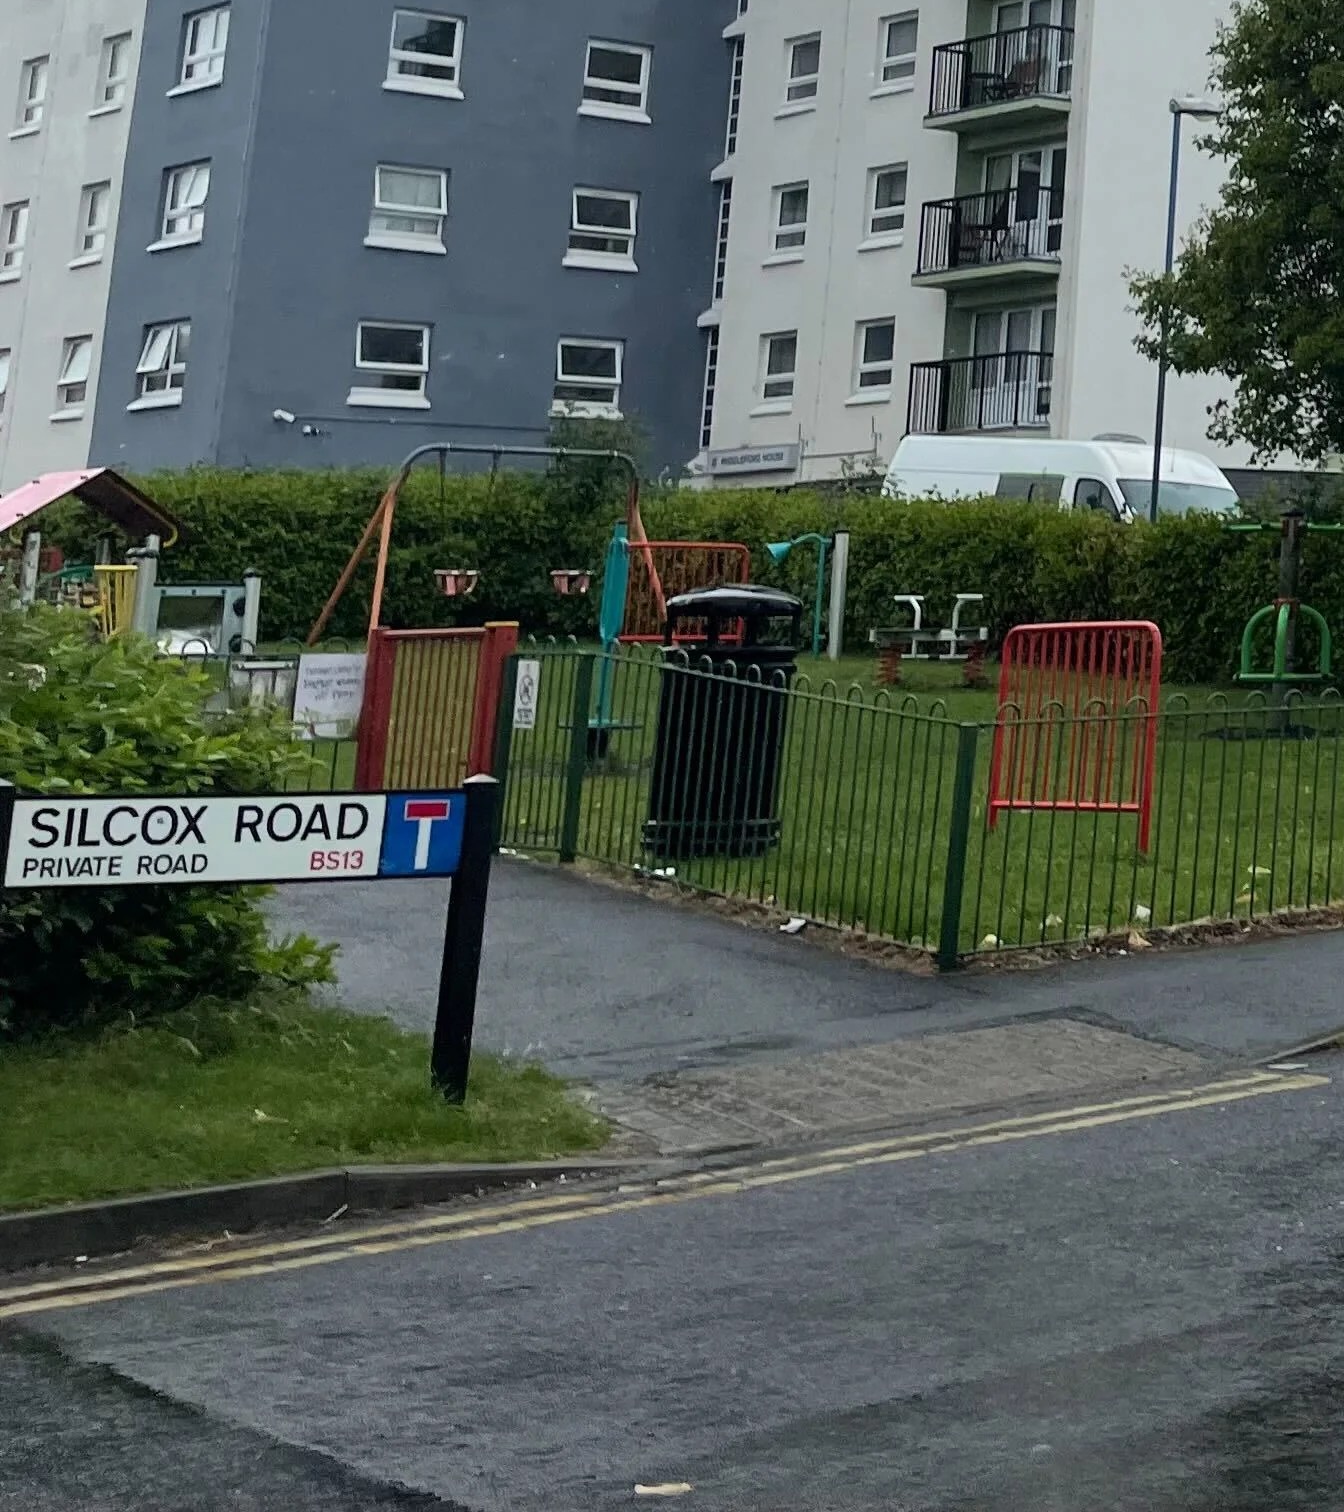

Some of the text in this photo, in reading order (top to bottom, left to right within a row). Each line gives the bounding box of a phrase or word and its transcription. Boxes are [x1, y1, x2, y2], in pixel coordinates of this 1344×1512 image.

[28, 802, 370, 849] SILCOX ROAD
[22, 853, 209, 879] PRIVATE ROAD
[309, 849, 364, 871] BS13
